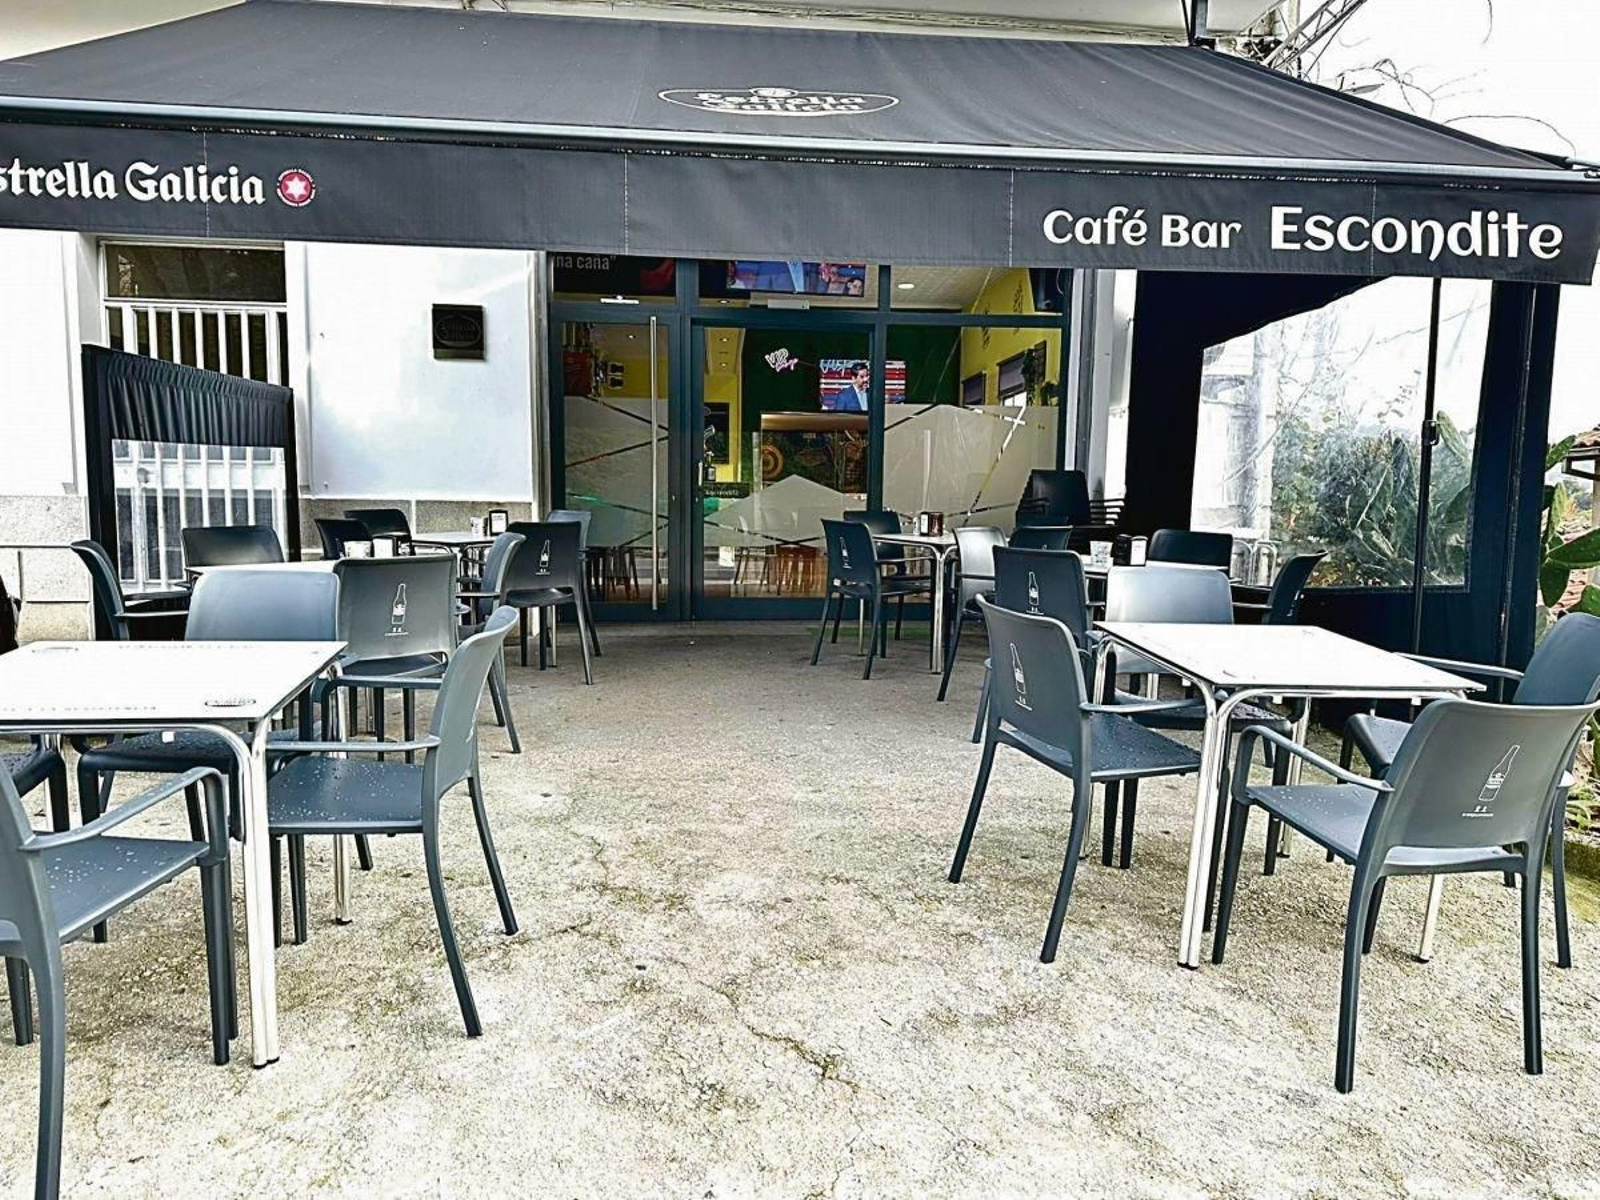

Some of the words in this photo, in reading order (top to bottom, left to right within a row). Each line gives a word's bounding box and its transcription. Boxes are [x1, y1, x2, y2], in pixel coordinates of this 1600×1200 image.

[125, 161, 266, 205] Galicia
[1043, 206, 1148, 246] Café
[1161, 214, 1242, 249] Bar
[1271, 206, 1563, 262] Escondite
